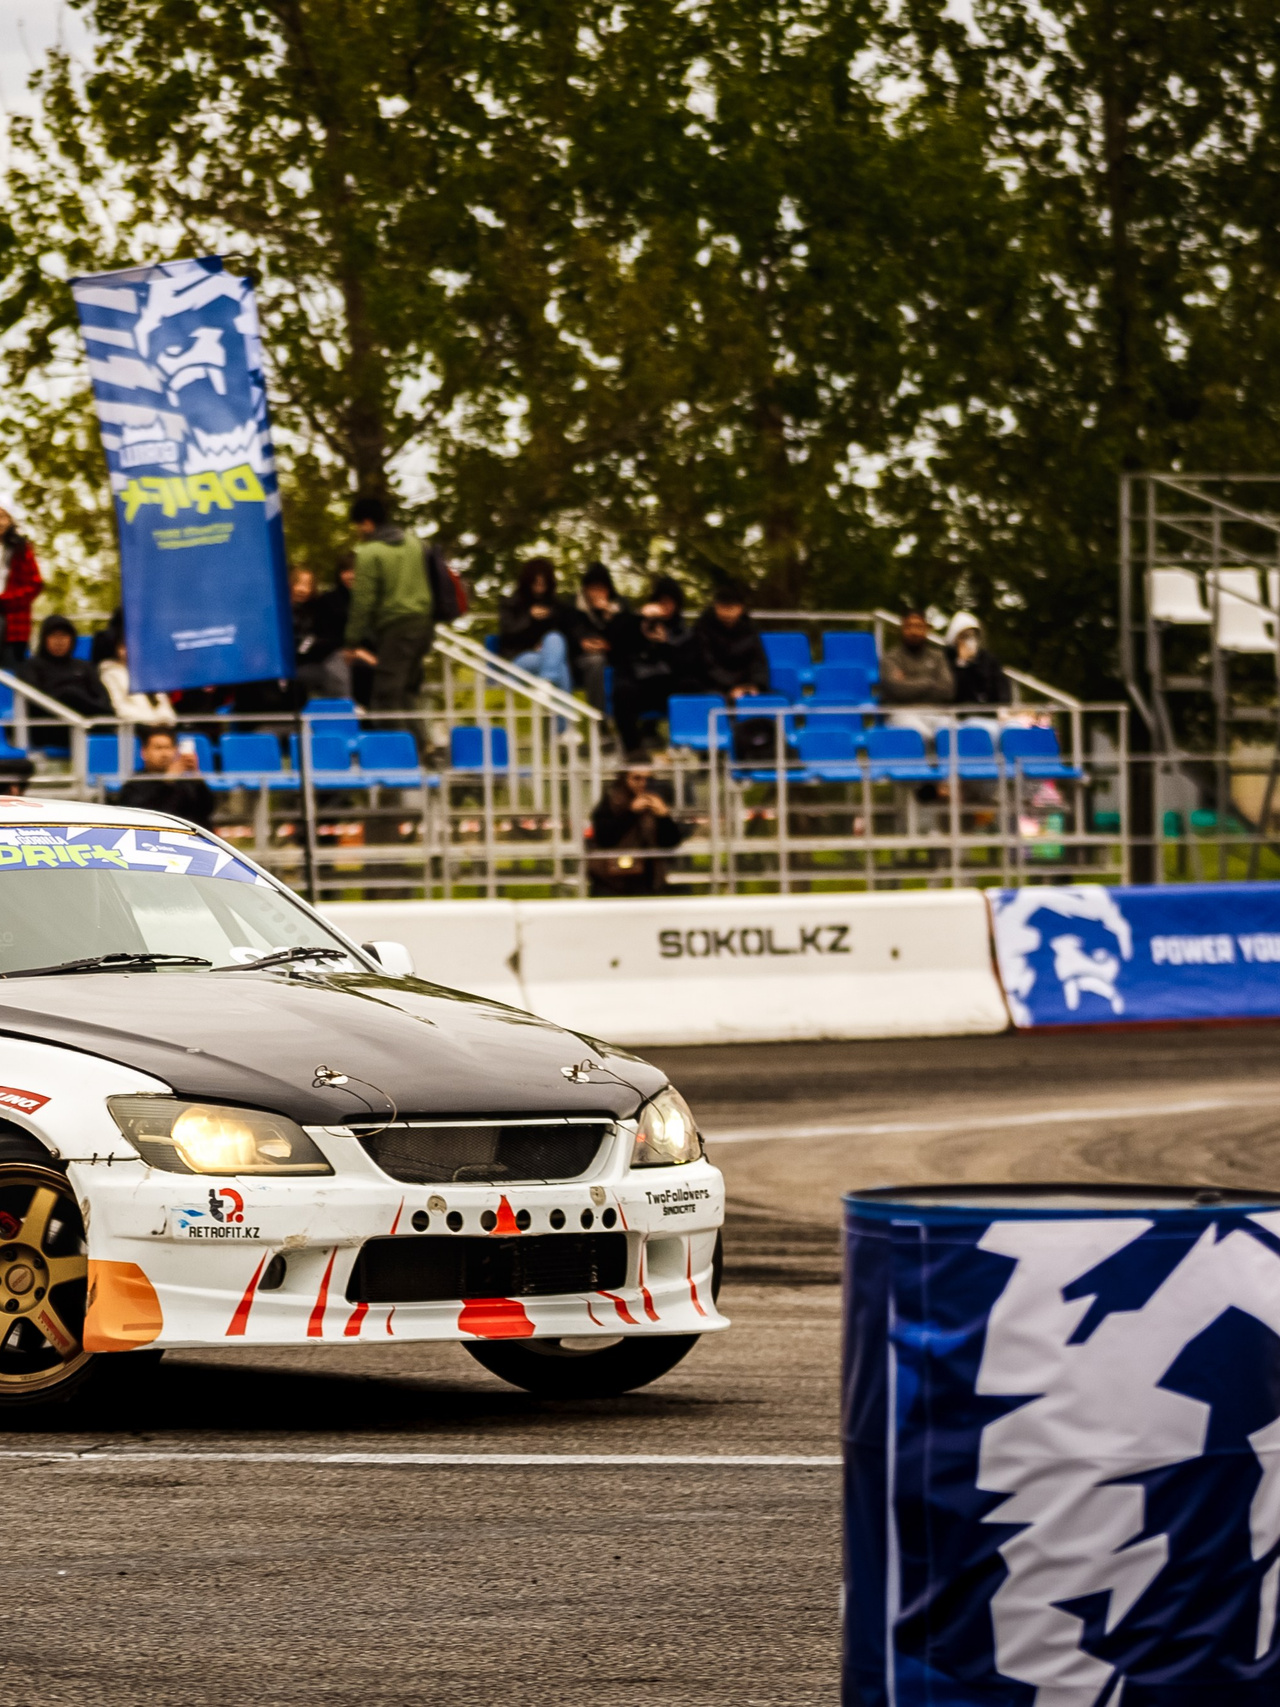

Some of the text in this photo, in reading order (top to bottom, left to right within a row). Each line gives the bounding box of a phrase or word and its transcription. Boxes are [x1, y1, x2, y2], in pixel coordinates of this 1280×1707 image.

[16, 836, 69, 846] GORILLA
[1150, 934, 1236, 965] POWER
[189, 1226, 260, 1239] RETROFIT.KZ
